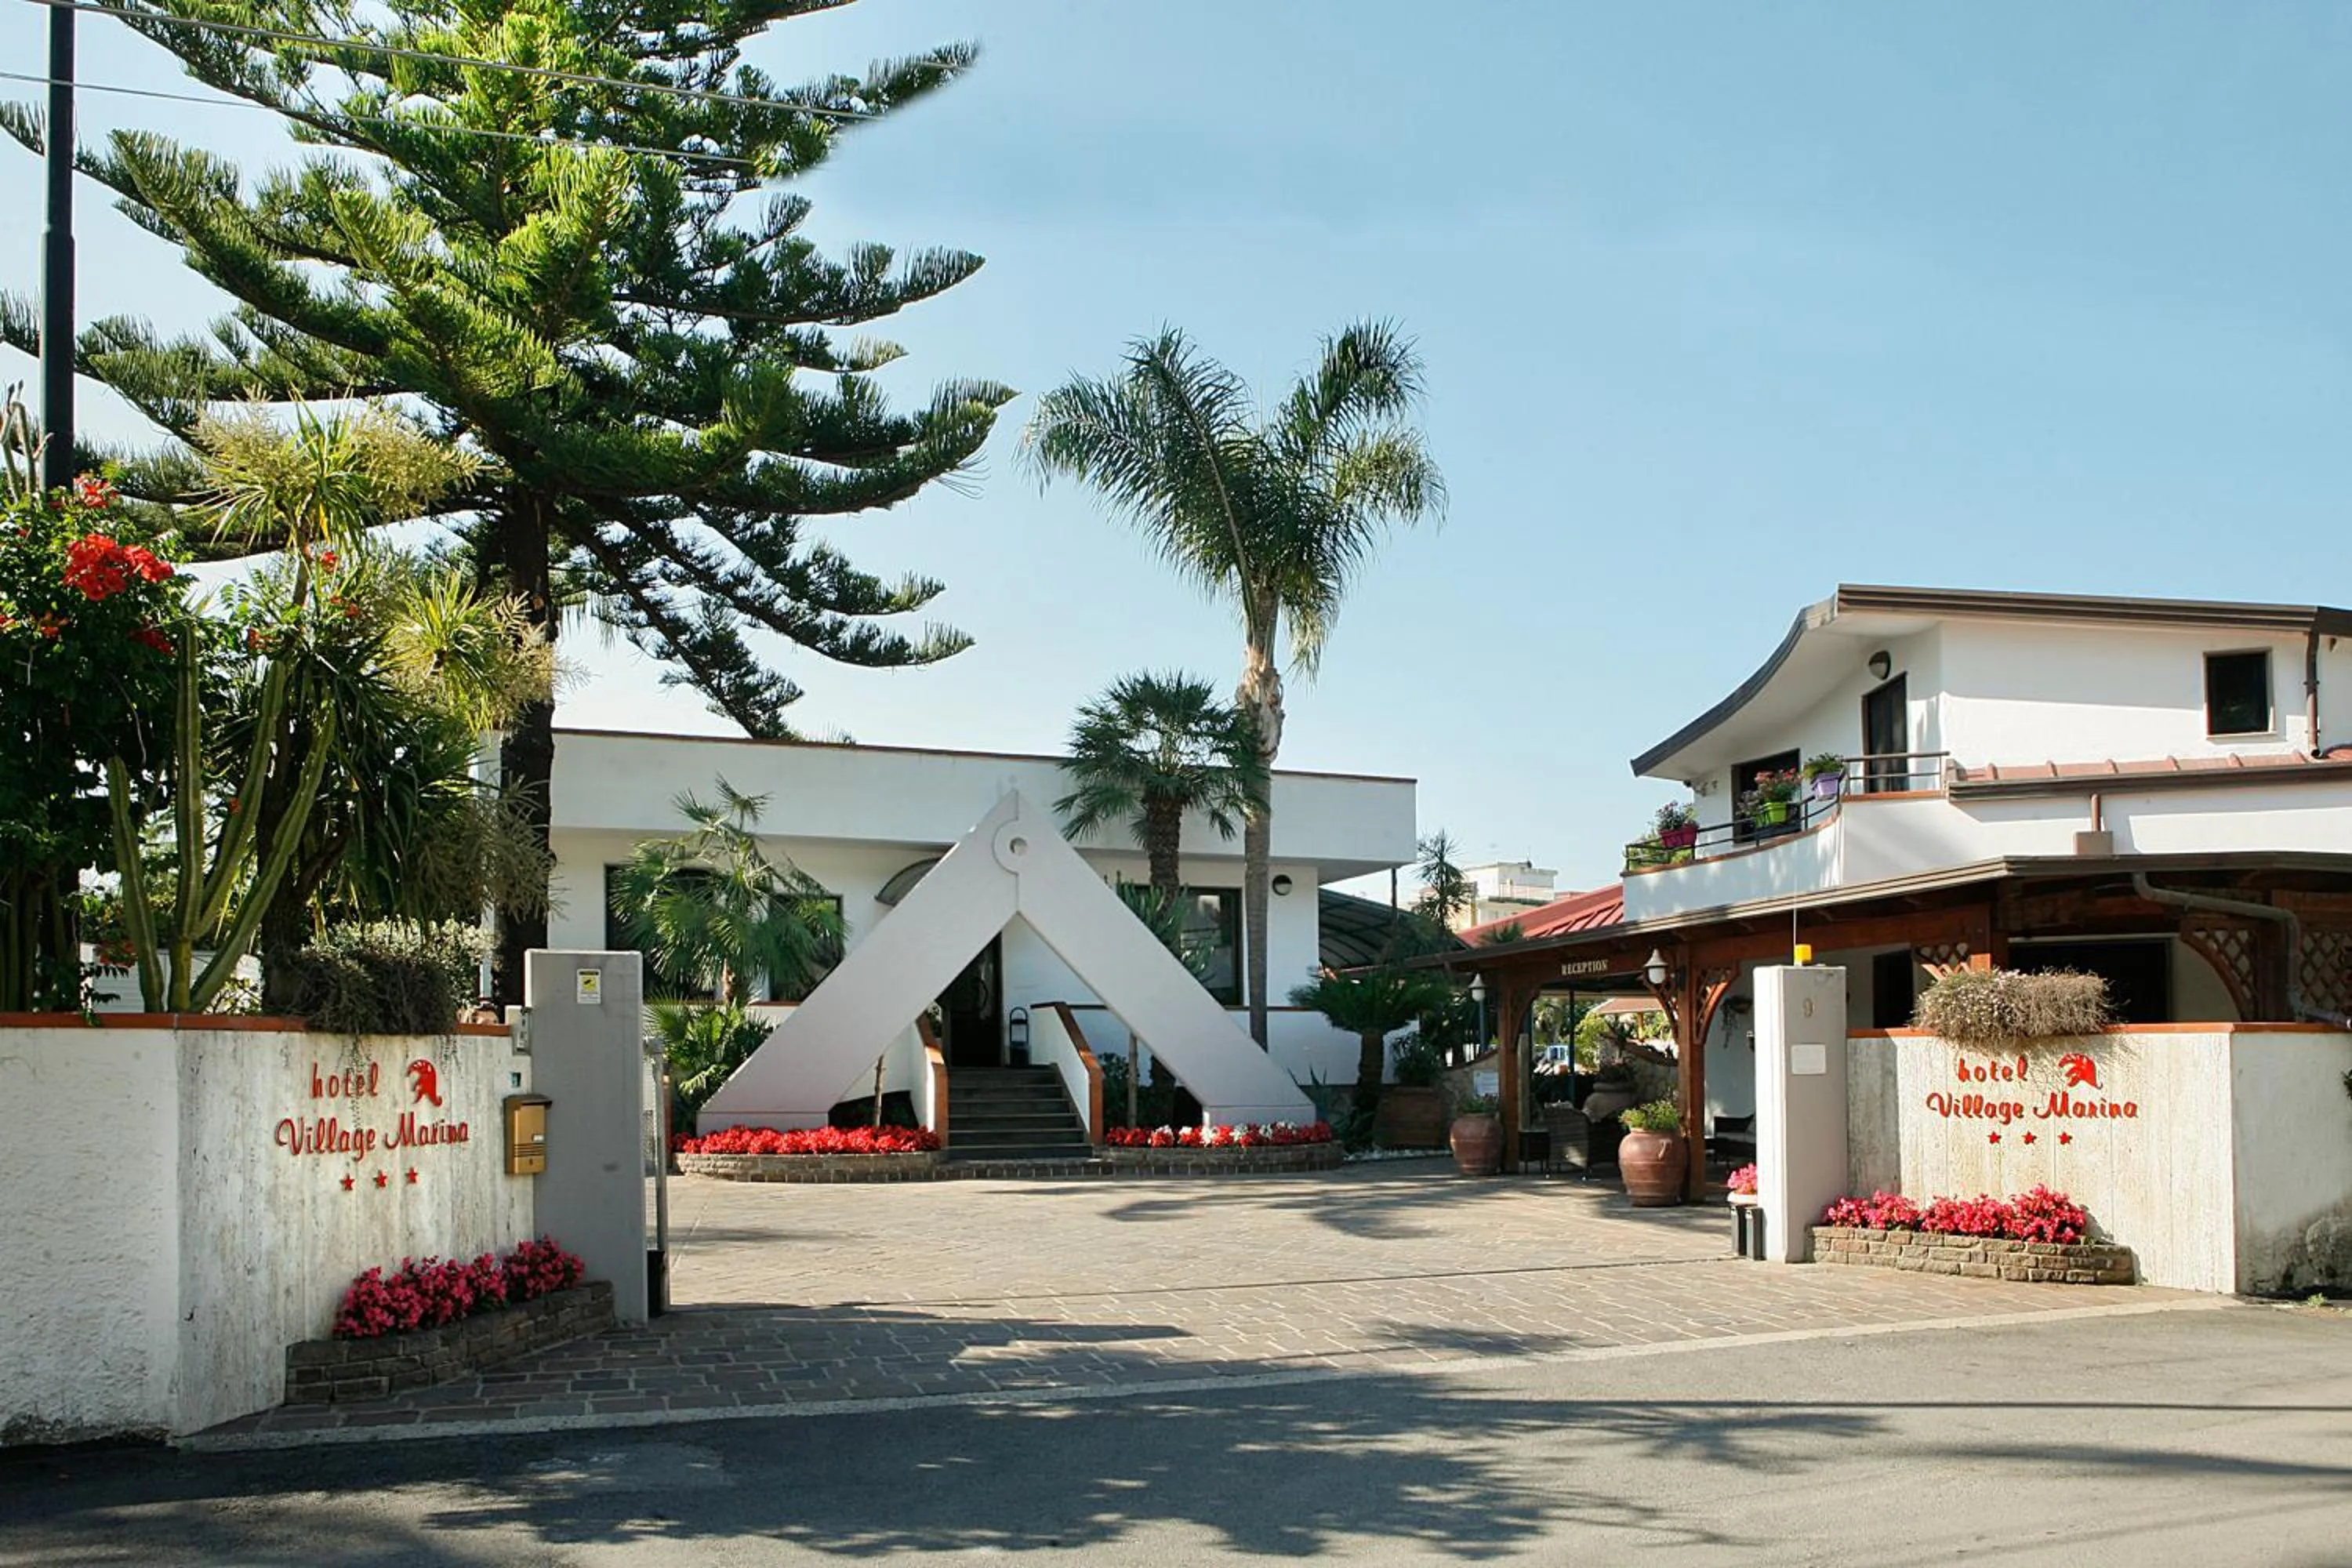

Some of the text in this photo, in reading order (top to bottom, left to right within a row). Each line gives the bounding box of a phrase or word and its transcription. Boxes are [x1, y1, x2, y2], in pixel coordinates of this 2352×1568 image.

[1561, 959, 1608, 975] RECEPTION
[310, 1062, 379, 1098] hotel
[1957, 1054, 2027, 1082] hotel
[1926, 1091, 2139, 1125] Village Marina
[276, 1112, 470, 1162] Village Marina
